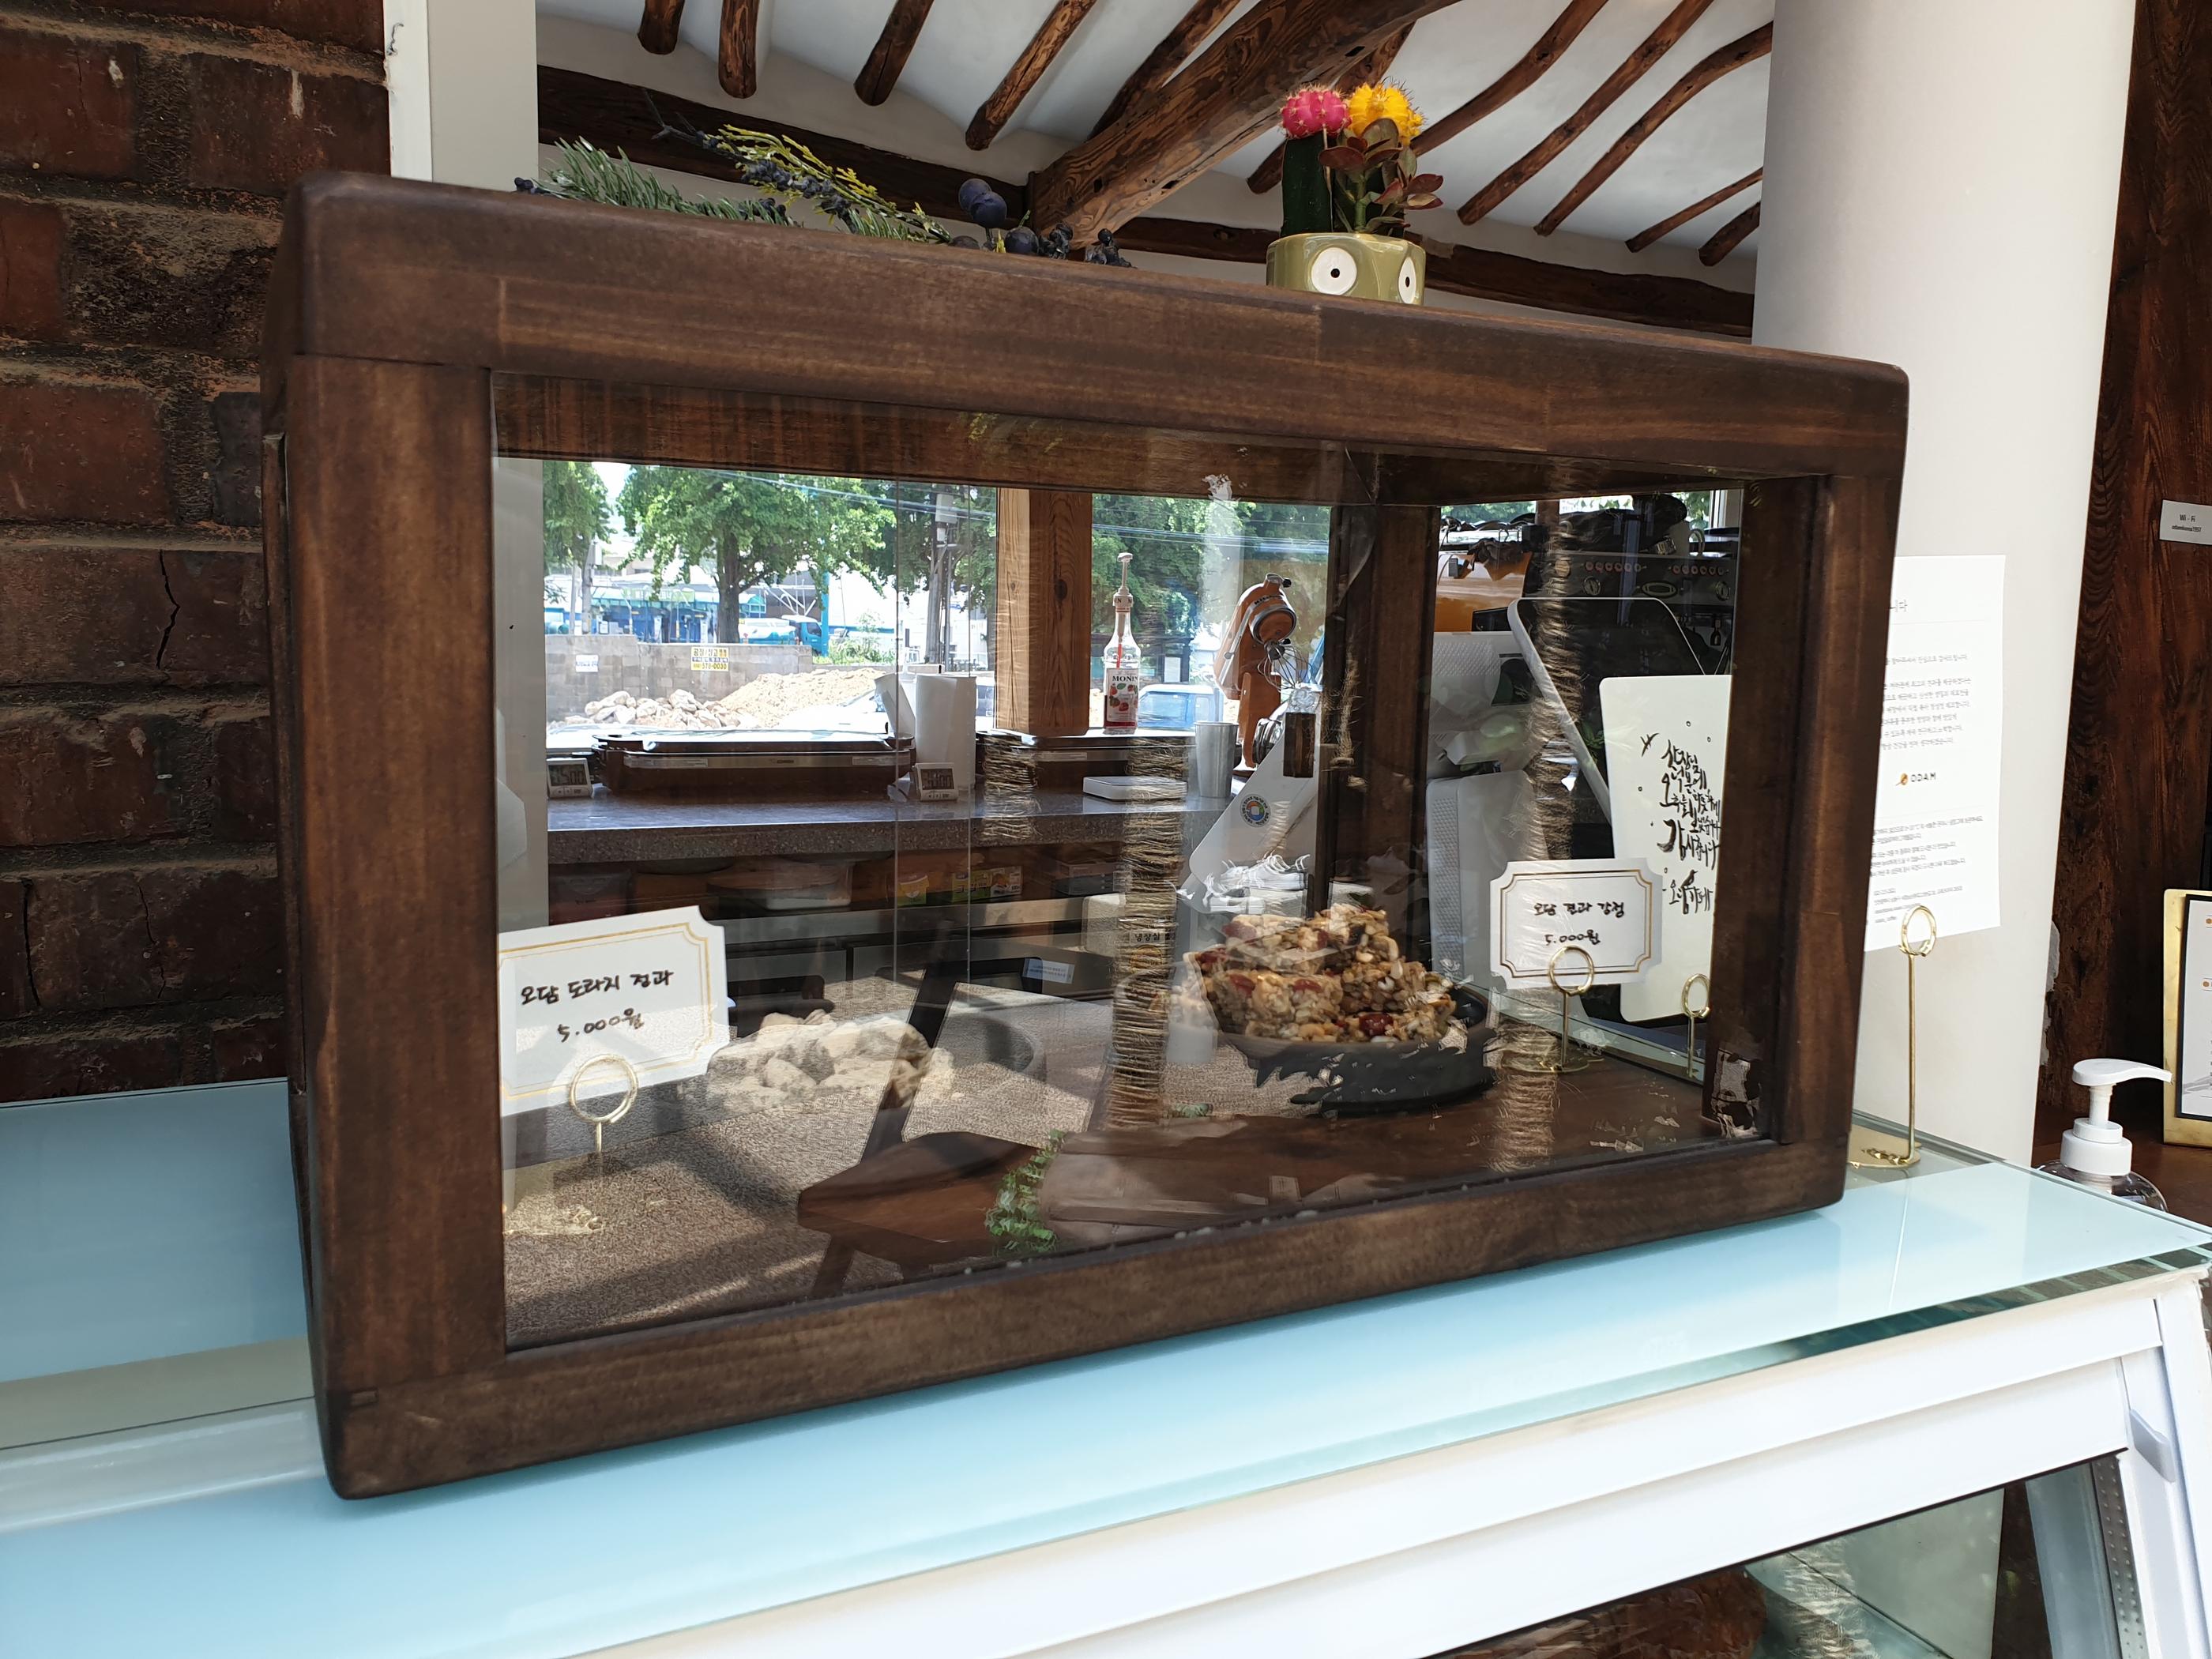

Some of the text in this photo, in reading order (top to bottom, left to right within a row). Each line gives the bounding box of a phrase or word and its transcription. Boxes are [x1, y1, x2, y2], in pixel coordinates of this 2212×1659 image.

[1533, 901, 1625, 919] 오담 견과 강정
[521, 969, 675, 1006] 오담 도라지 정과
